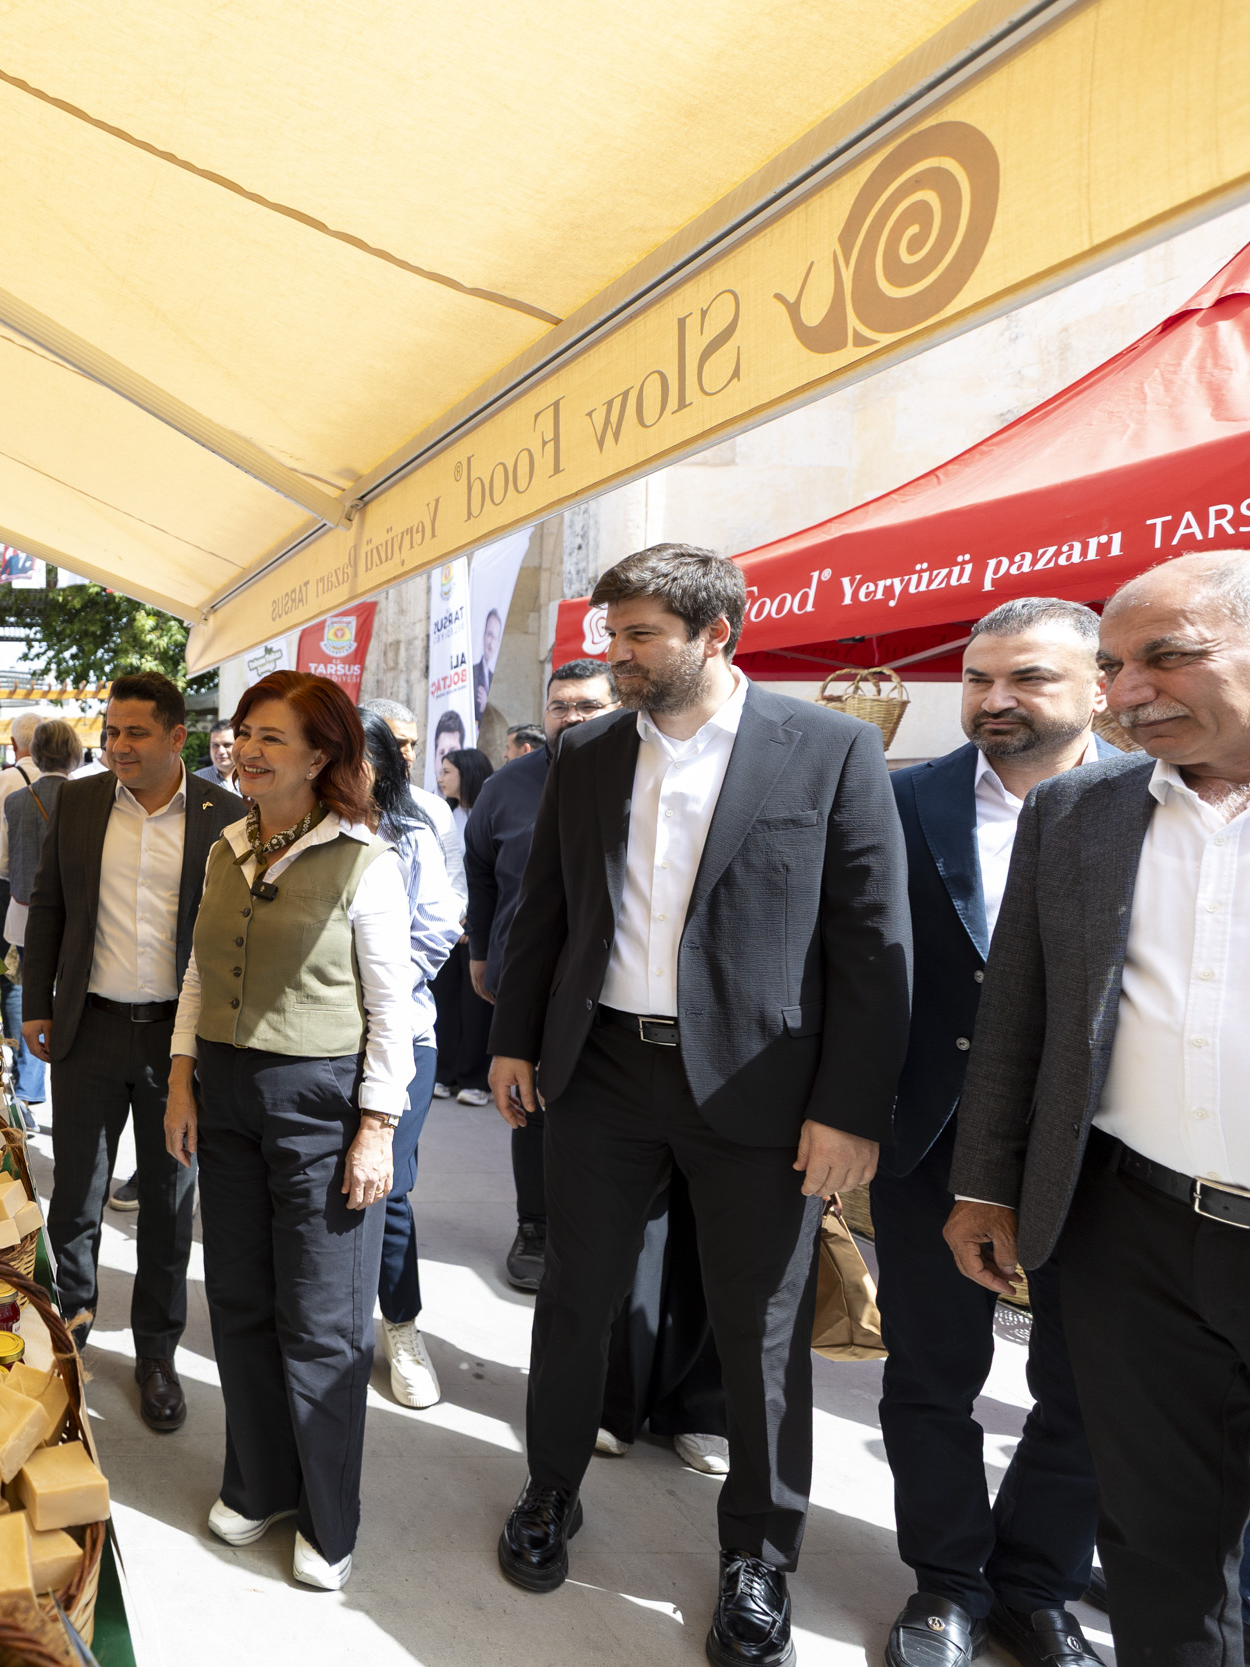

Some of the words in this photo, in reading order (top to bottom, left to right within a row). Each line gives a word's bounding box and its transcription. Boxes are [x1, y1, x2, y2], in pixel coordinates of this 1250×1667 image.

[839, 553, 972, 608] Yeryüzü
[981, 530, 1124, 592] pazarı
[308, 662, 361, 676] TARSUS
